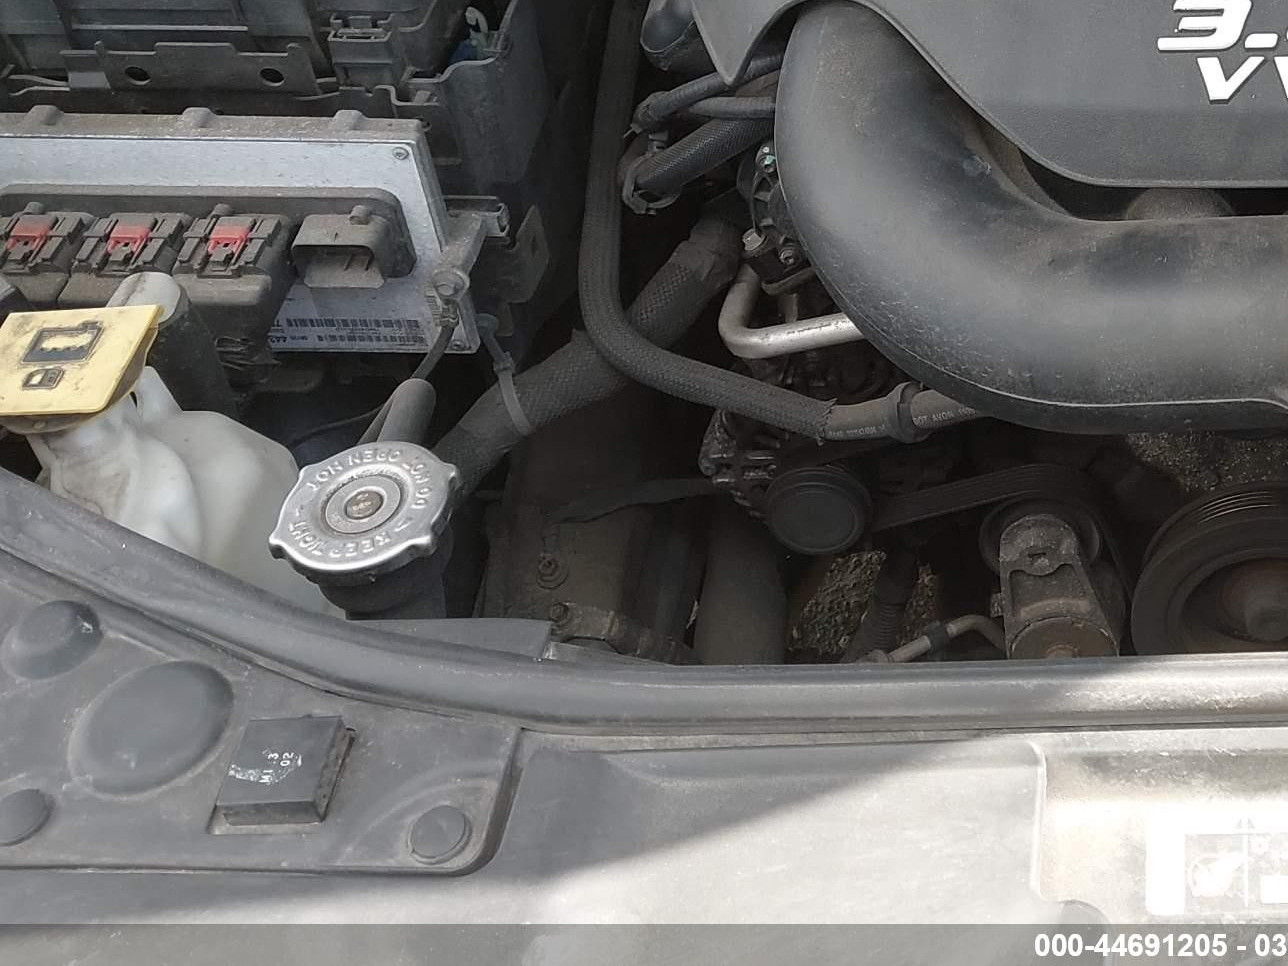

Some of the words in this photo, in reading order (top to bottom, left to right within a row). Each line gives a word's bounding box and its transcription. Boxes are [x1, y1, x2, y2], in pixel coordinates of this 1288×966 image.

[348, 449, 402, 467] OPEN
[287, 520, 328, 557] TIGHT
[327, 531, 393, 558] KEEP
